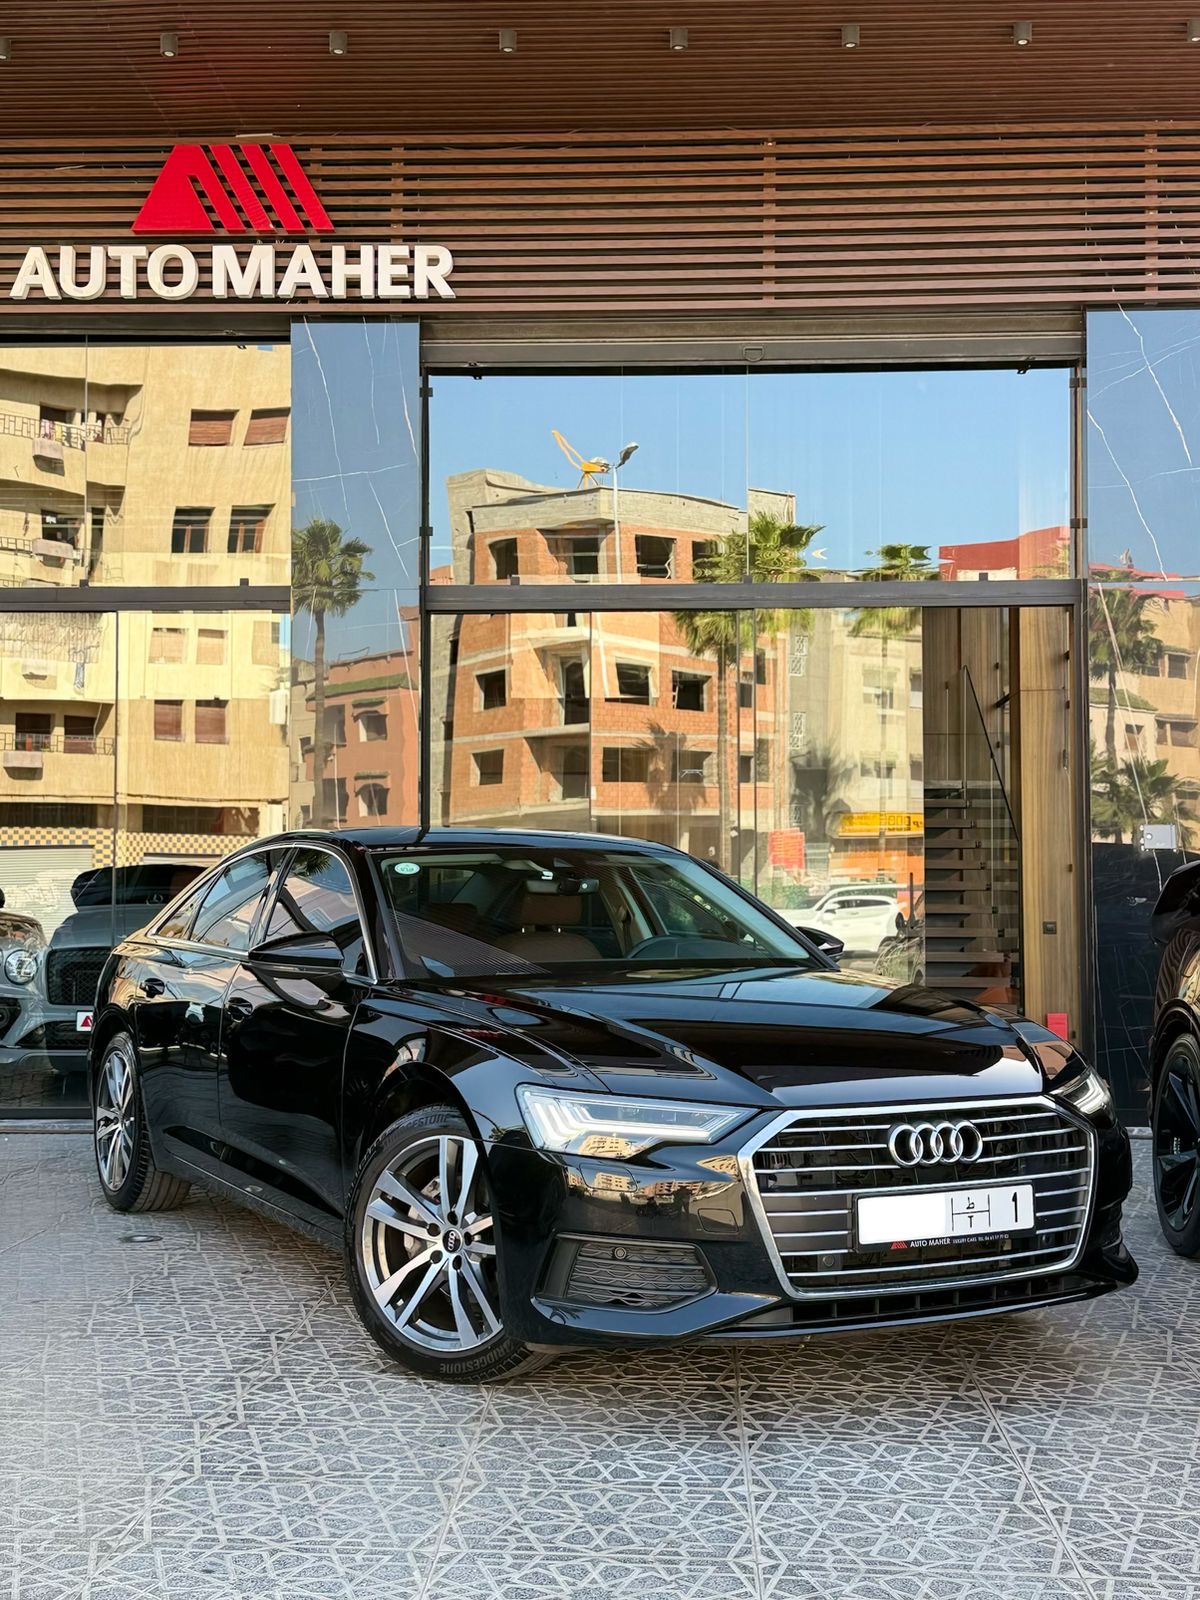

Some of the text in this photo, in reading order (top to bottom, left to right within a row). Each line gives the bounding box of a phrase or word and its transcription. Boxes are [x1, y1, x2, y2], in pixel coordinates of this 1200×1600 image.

[9, 244, 456, 300] AUTO MAHER
[1012, 1192, 1018, 1222] 1
[968, 1216, 974, 1228] T
[910, 1240, 928, 1248] AUTO
[928, 1238, 951, 1246] MAHER
